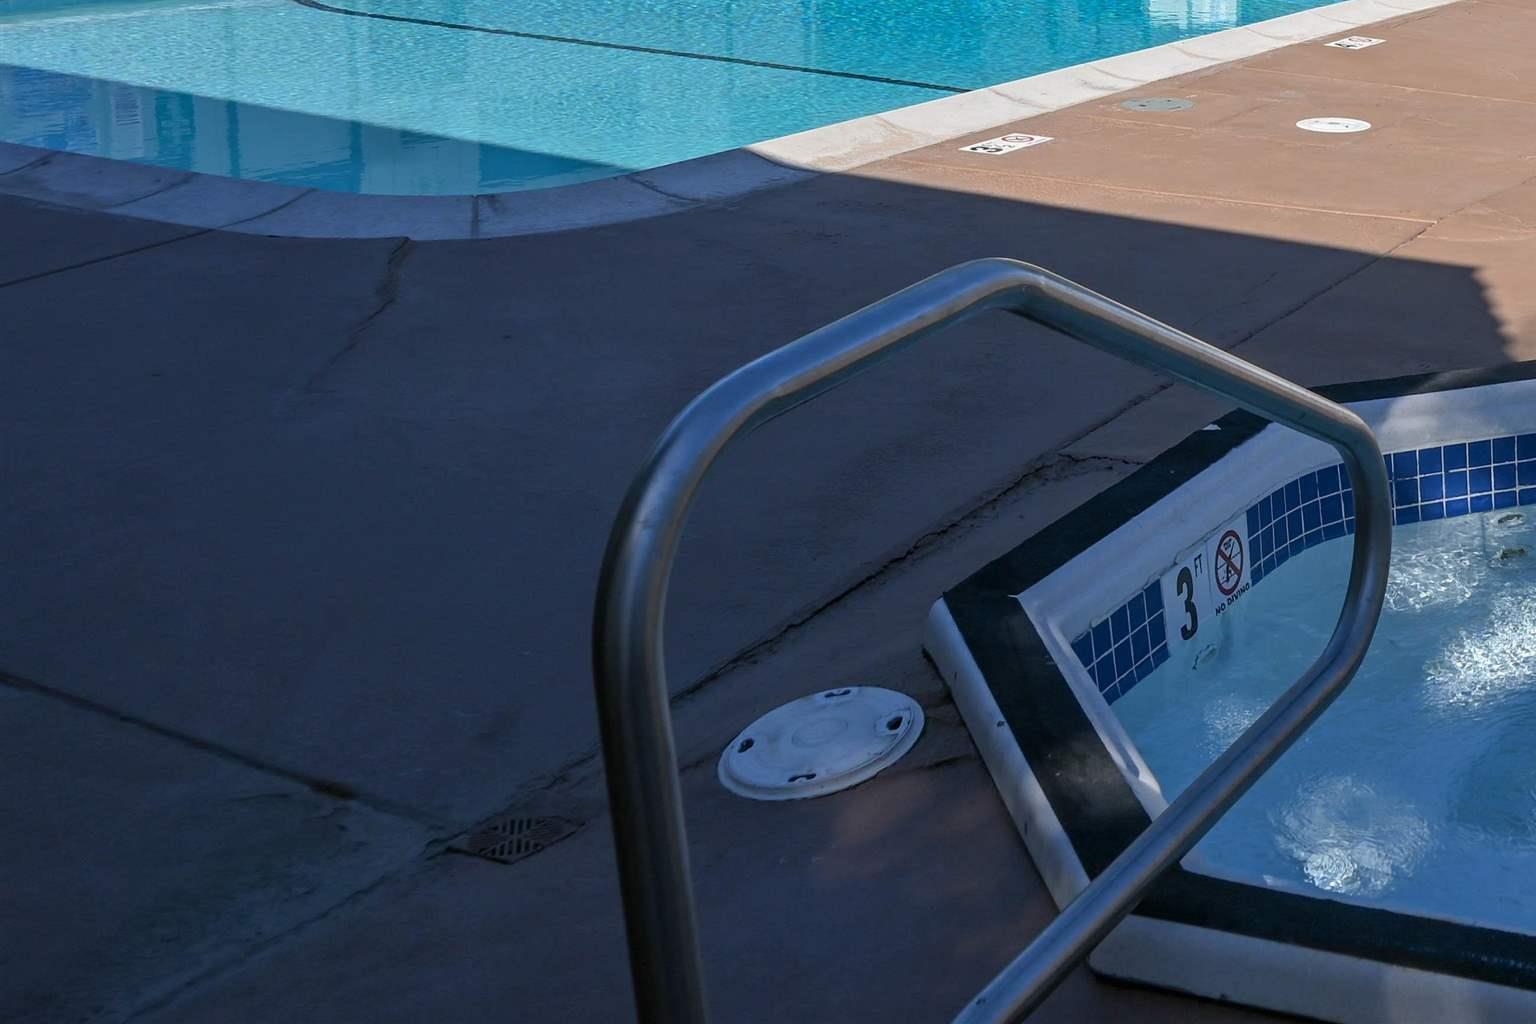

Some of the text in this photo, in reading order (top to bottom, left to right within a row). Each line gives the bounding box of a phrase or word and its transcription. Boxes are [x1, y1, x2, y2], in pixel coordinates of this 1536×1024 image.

[1176, 554, 1203, 640] 3 FT
[1215, 582, 1250, 616] NO DIVING
